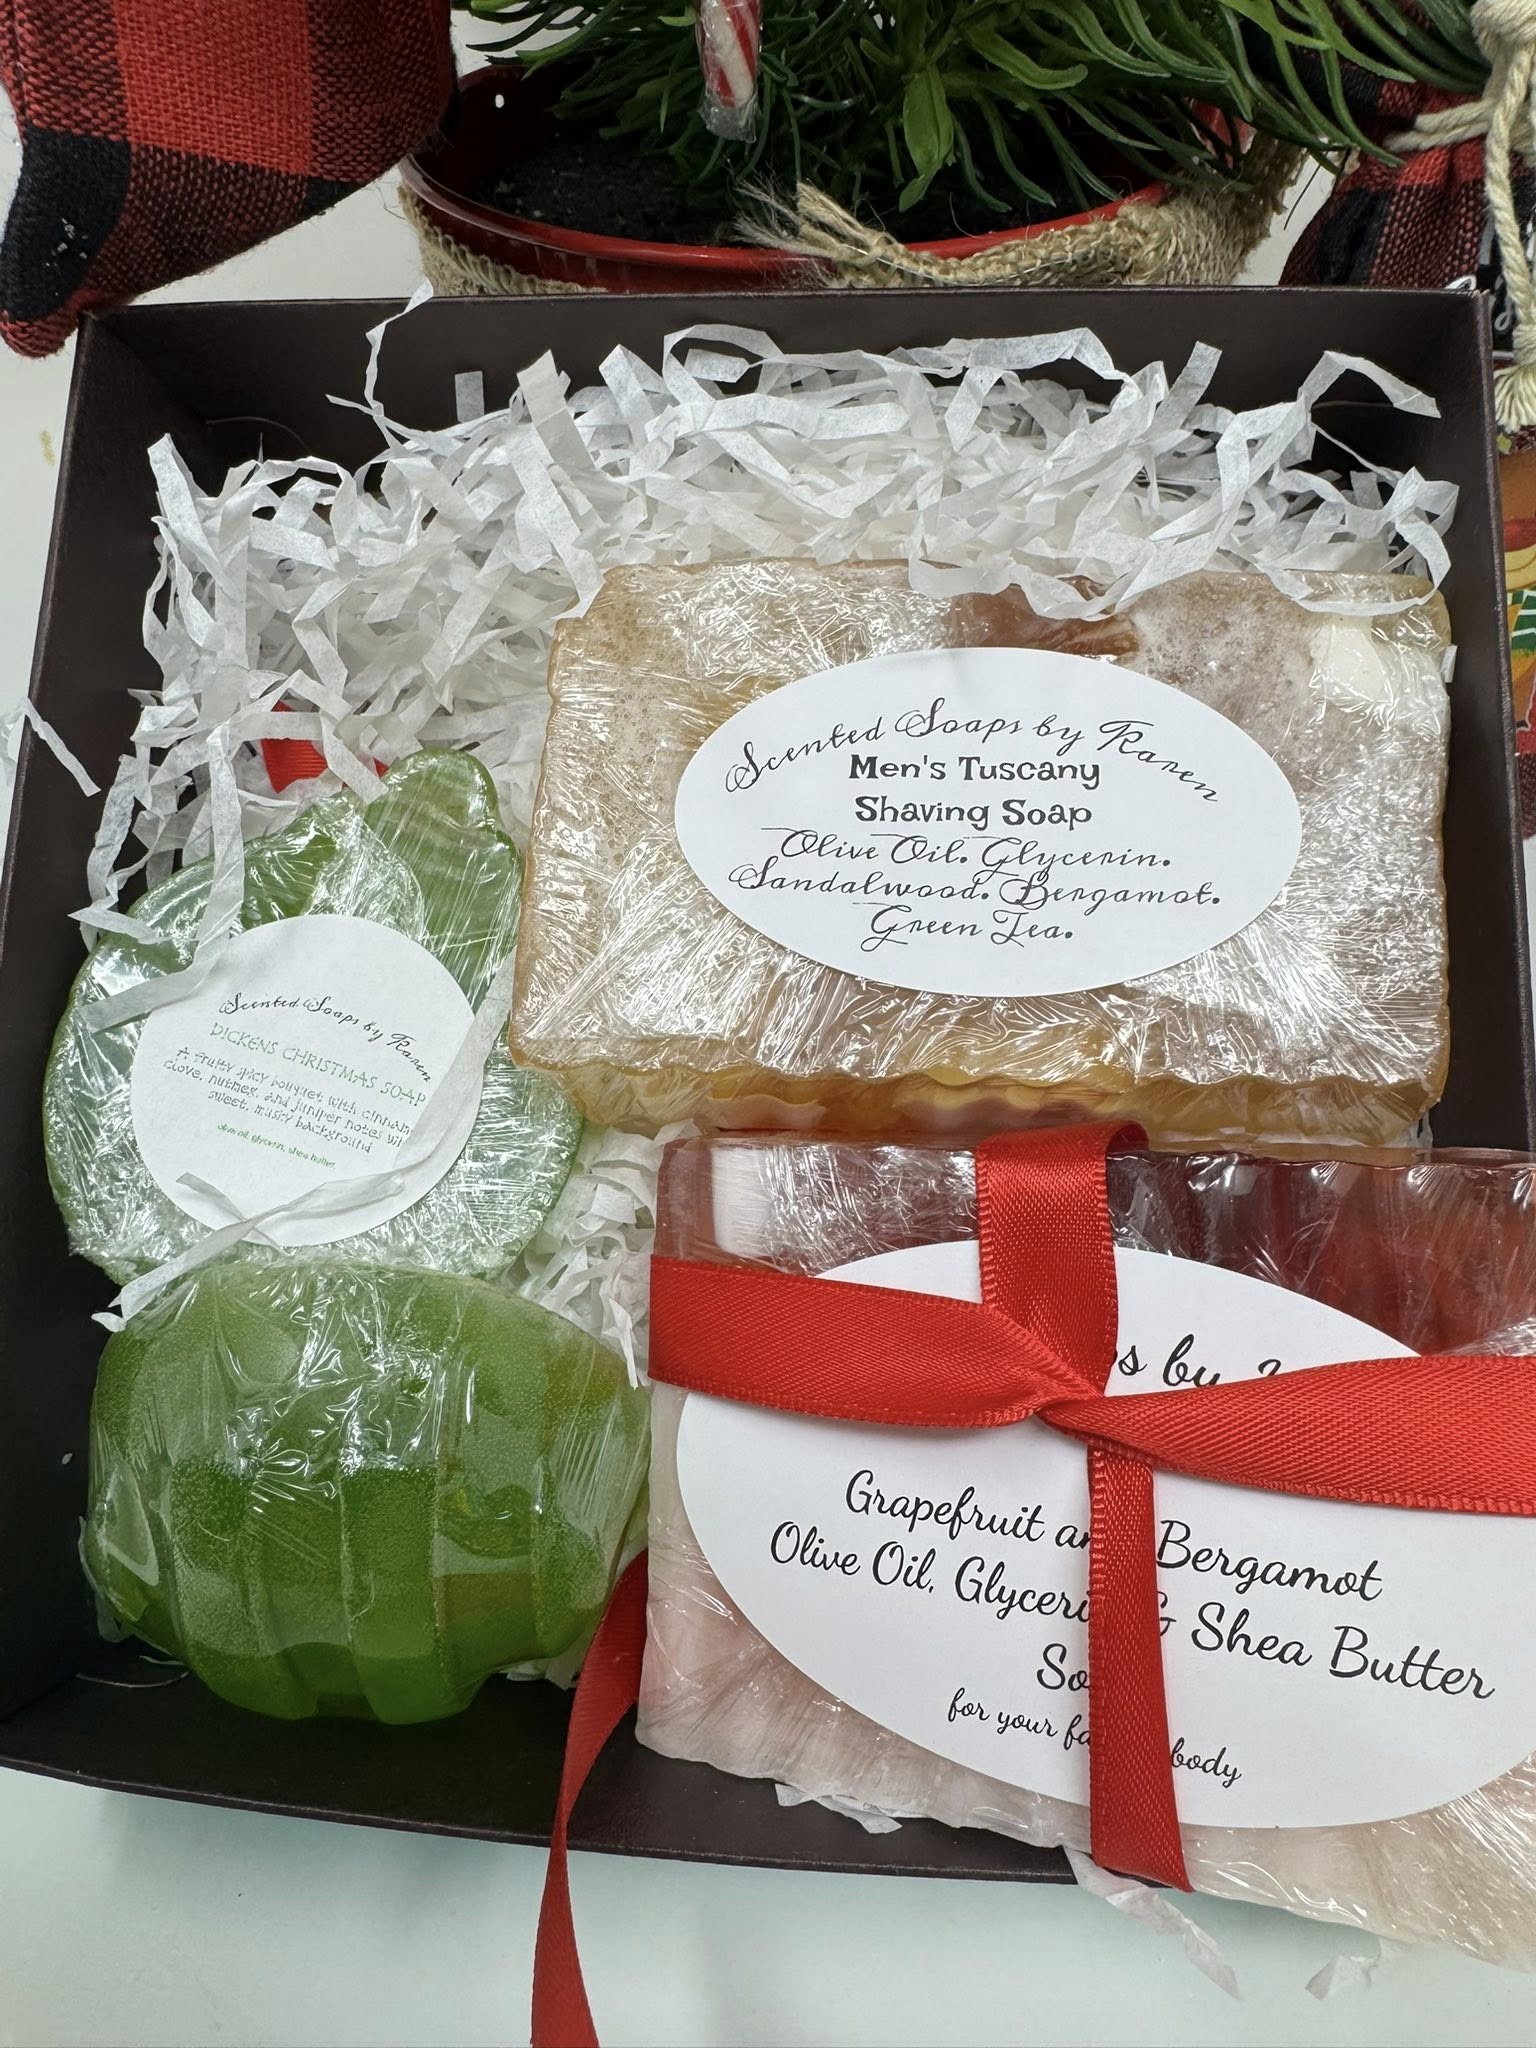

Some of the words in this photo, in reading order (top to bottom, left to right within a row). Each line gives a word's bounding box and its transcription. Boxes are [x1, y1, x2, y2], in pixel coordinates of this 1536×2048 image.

[726, 716, 885, 792] Scented
[895, 697, 1023, 743] Soaps
[1032, 714, 1085, 757] by
[1097, 720, 1219, 802] Karen
[849, 754, 946, 780] Men's
[959, 756, 1100, 790] Tuscany
[855, 795, 989, 831] Shaving
[1002, 799, 1092, 831] Soap
[761, 828, 879, 857] Olive
[852, 902, 983, 952] Green
[219, 992, 300, 1014] Scented
[303, 996, 360, 1024] Soaps
[363, 1021, 384, 1042] by
[386, 1033, 431, 1083] Karen
[209, 1022, 279, 1055] DICKENS
[282, 1048, 378, 1088] CHRISTMAS
[380, 1081, 426, 1107] SOAP
[264, 1092, 291, 1108] and
[291, 1098, 342, 1123] juniper
[344, 1119, 381, 1139] notes
[328, 1095, 356, 1114] with
[295, 1115, 373, 1153] background
[846, 1469, 1046, 1540] Grapefruit
[1156, 1519, 1383, 1601] Bergamot
[770, 1521, 861, 1575] Olive
[954, 1556, 1090, 1622] Glyceri
[1191, 1602, 1312, 1666] Shea
[1329, 1625, 1495, 1700] Butter
[948, 1687, 990, 1722] for
[996, 1711, 1058, 1737] your
[1170, 1737, 1242, 1789] body
